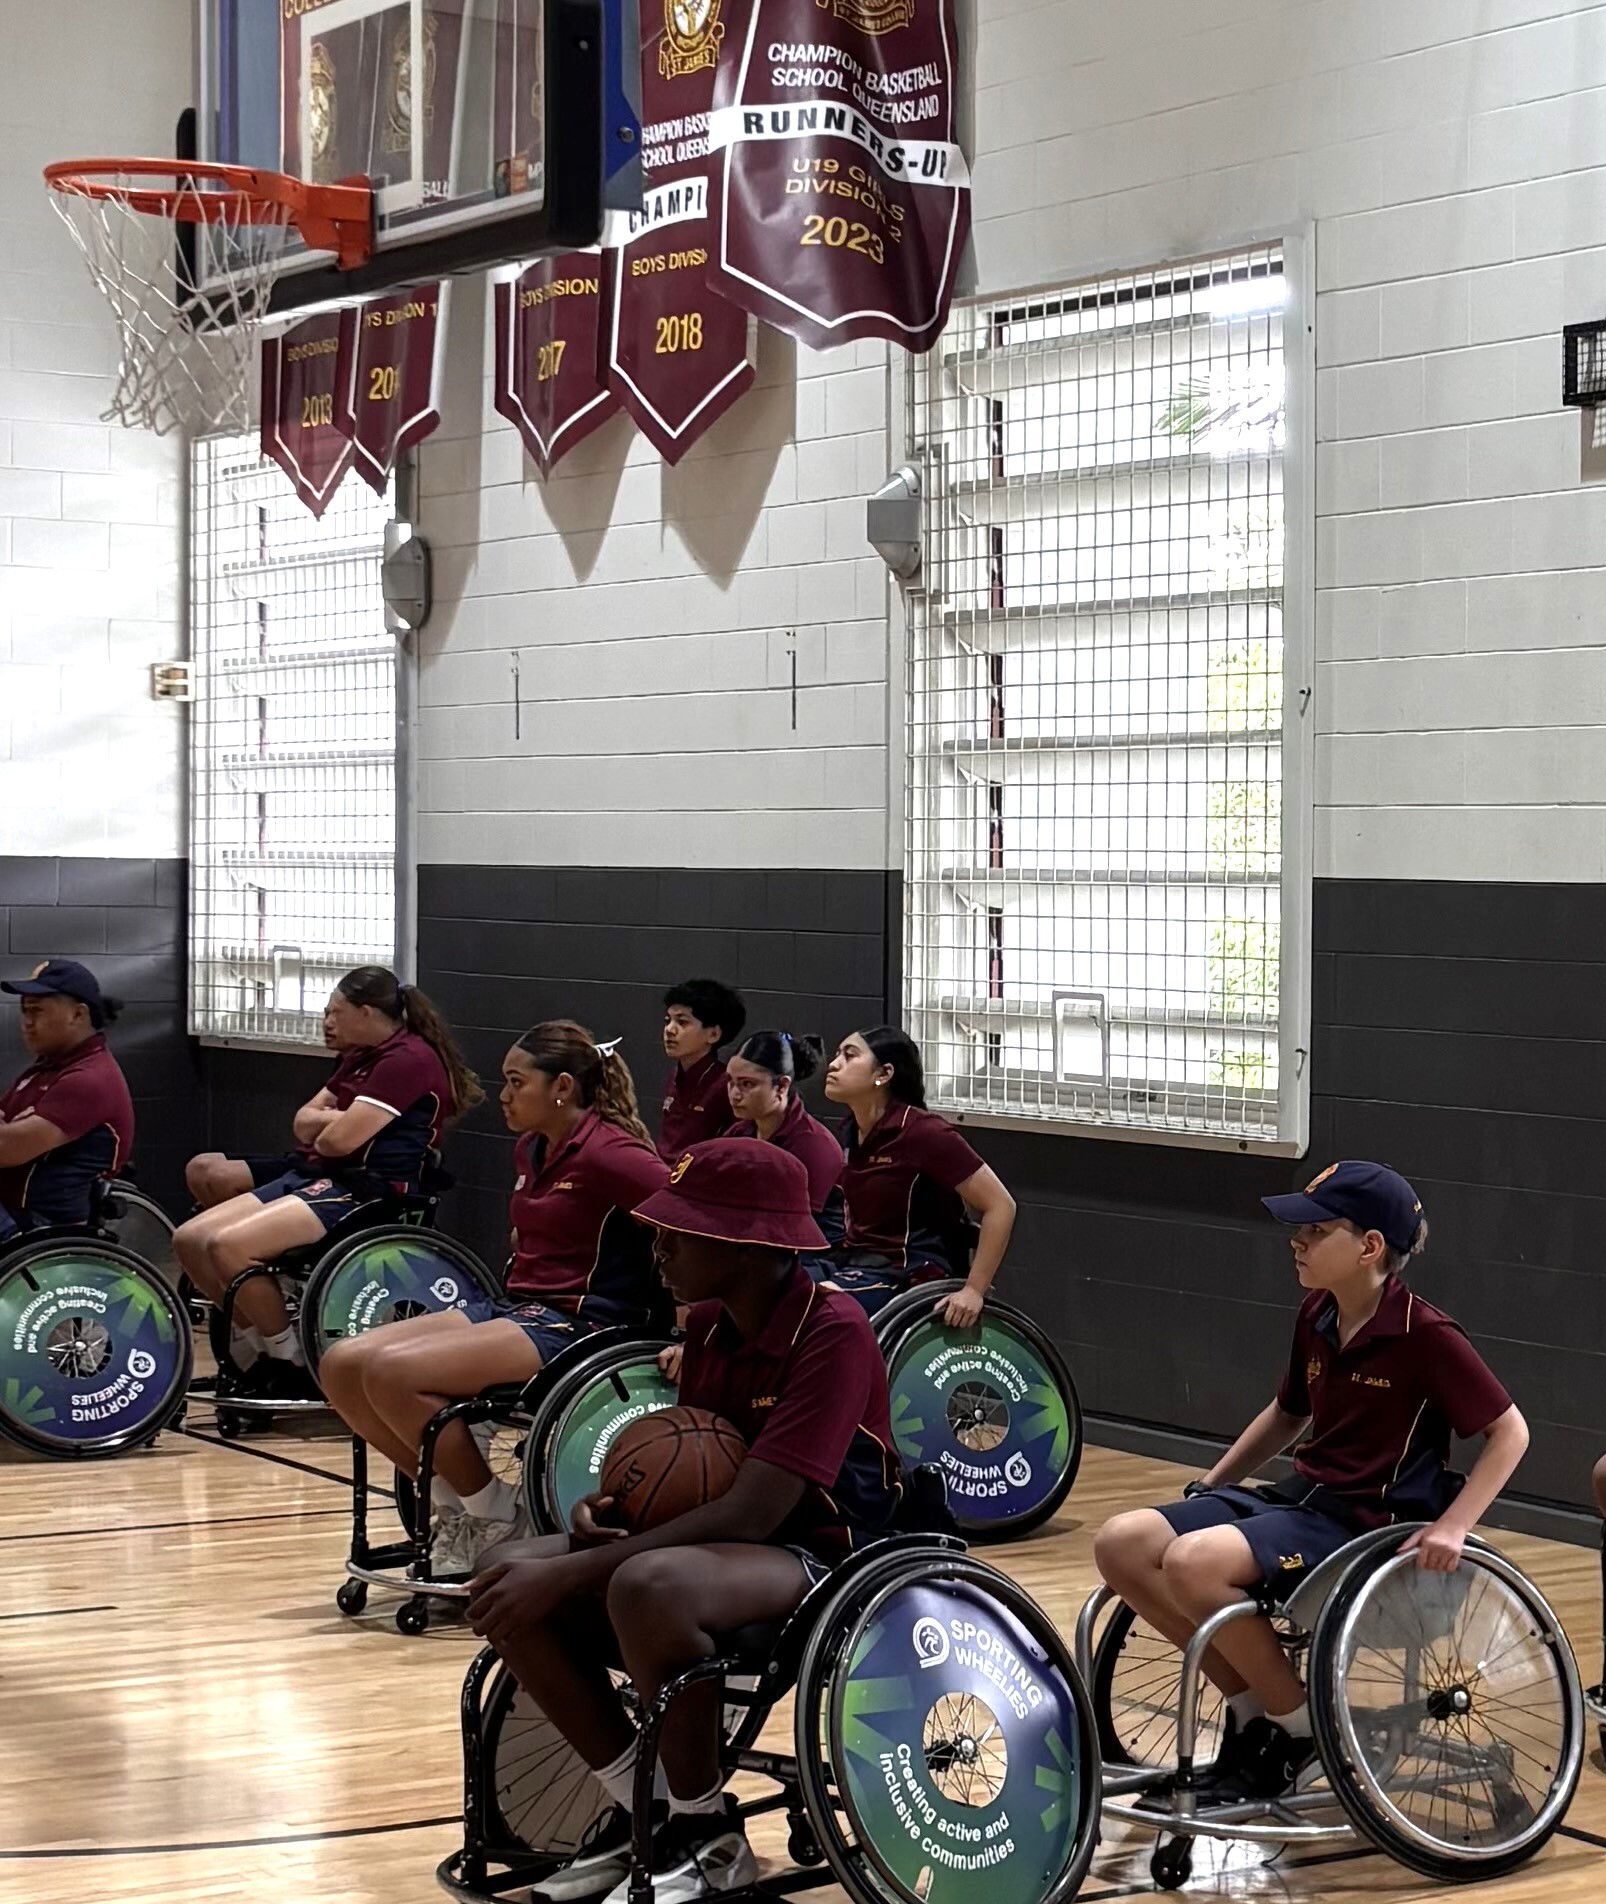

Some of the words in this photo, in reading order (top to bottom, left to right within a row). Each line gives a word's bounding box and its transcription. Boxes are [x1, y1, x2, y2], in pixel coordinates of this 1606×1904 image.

[767, 42, 863, 80] CHAMPION
[864, 61, 943, 96] BASKETBALL
[771, 67, 849, 92] SCHOOL
[852, 82, 940, 124] QUEENSLAND
[792, 157, 840, 174] U19
[800, 214, 884, 264] 2023
[655, 312, 704, 354] 2018
[398, 1210, 425, 1227] 17
[71, 1373, 133, 1406] WHEELIES
[71, 1380, 145, 1422] SPORTING
[940, 1450, 1003, 1480] WHEELIES
[950, 1618, 1043, 1710] SPORTING
[954, 1645, 1029, 1721] WHEELIES
[879, 1751, 921, 1841] inclusive
[921, 1836, 1016, 1871] communities
[897, 1742, 937, 1828] Creating
[937, 1813, 982, 1844] active
[985, 1810, 1010, 1840] and
